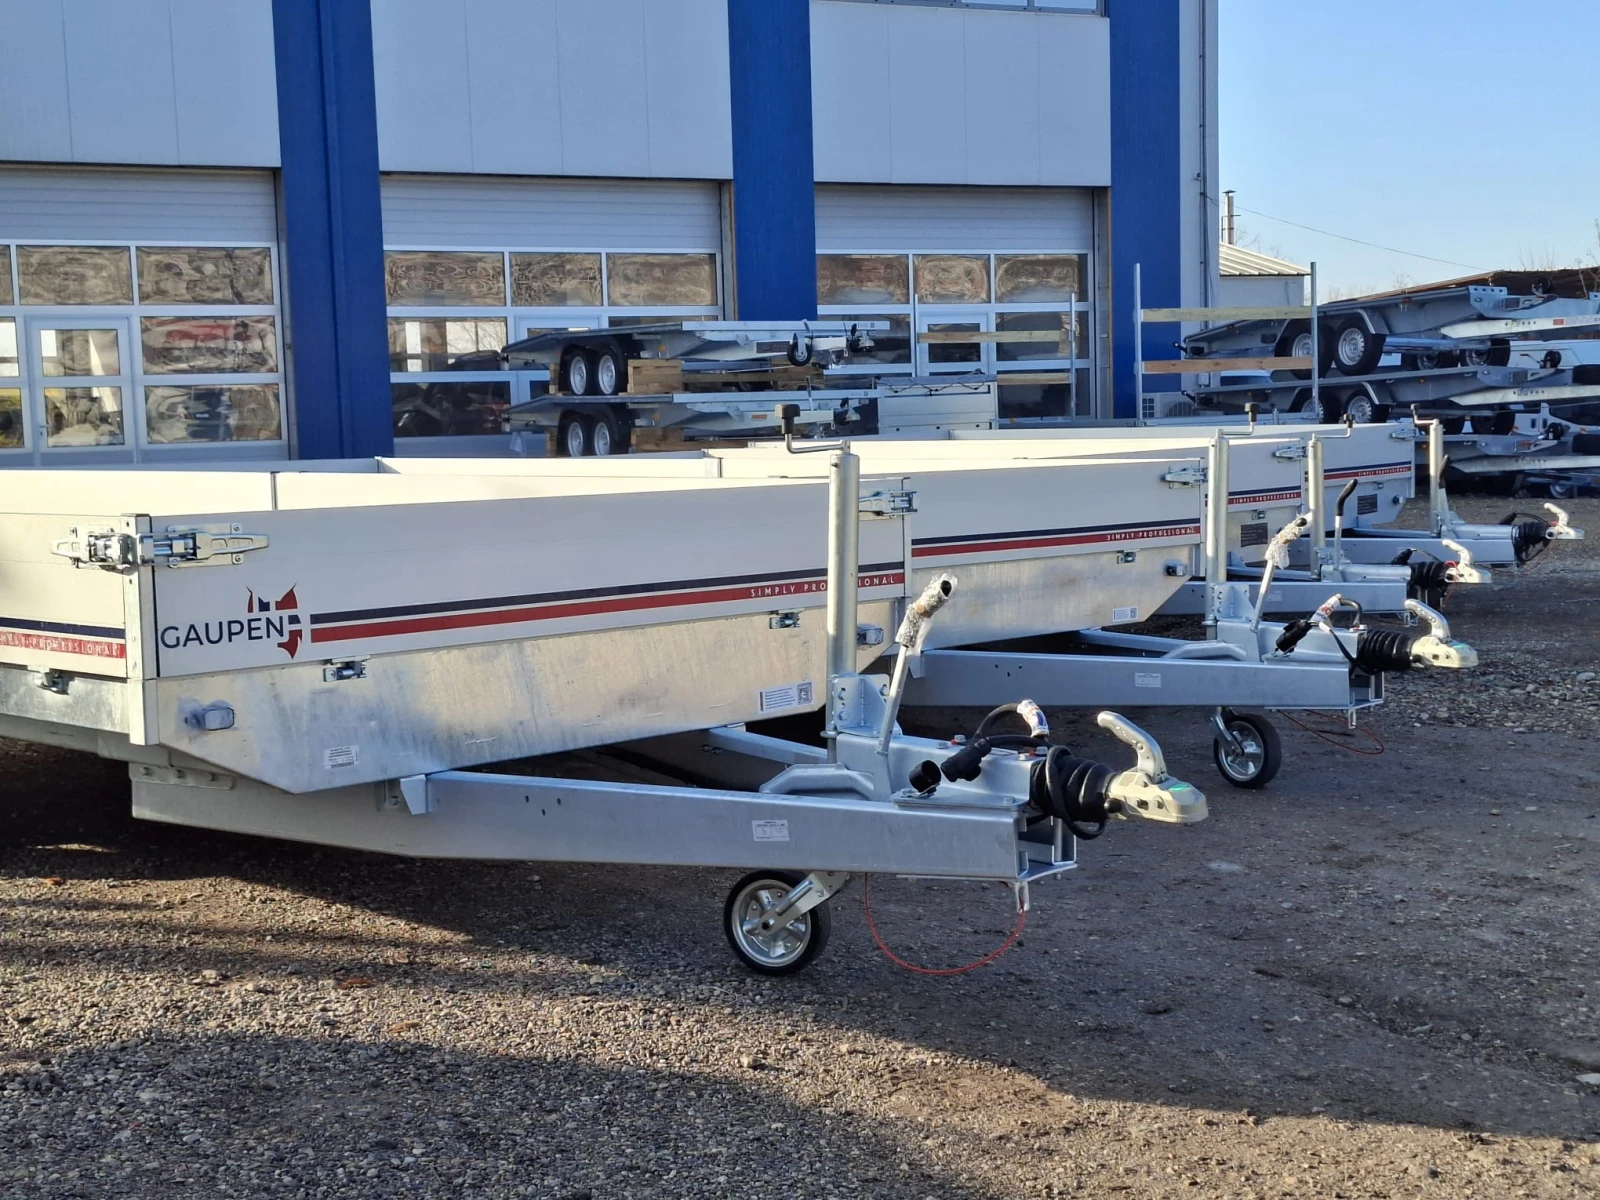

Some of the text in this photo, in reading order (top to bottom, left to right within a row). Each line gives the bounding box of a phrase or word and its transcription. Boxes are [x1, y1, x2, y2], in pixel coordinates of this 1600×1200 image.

[1107, 527, 1195, 541] SIMPLY PROFESSIONAL
[750, 575, 895, 597] SIMPLY PROIONAL
[160, 615, 284, 649] GAUPEN
